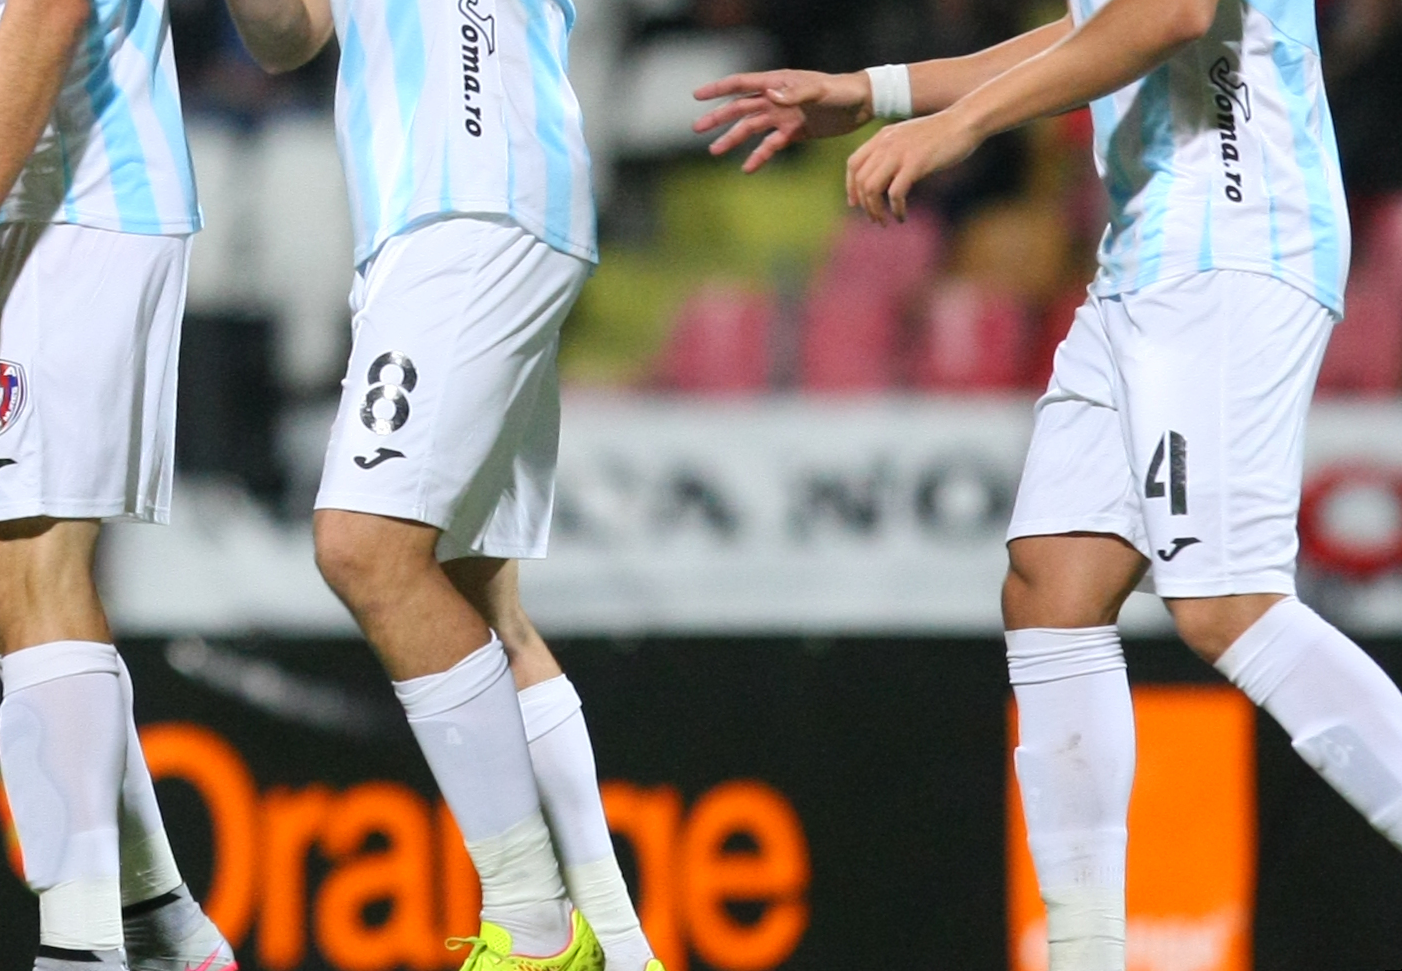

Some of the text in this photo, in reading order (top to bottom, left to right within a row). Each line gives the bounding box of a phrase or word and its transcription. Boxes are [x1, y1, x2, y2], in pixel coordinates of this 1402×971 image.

[1209, 57, 1251, 204] Joma.ro
[359, 350, 418, 436] 8
[1145, 429, 1188, 516] 4
